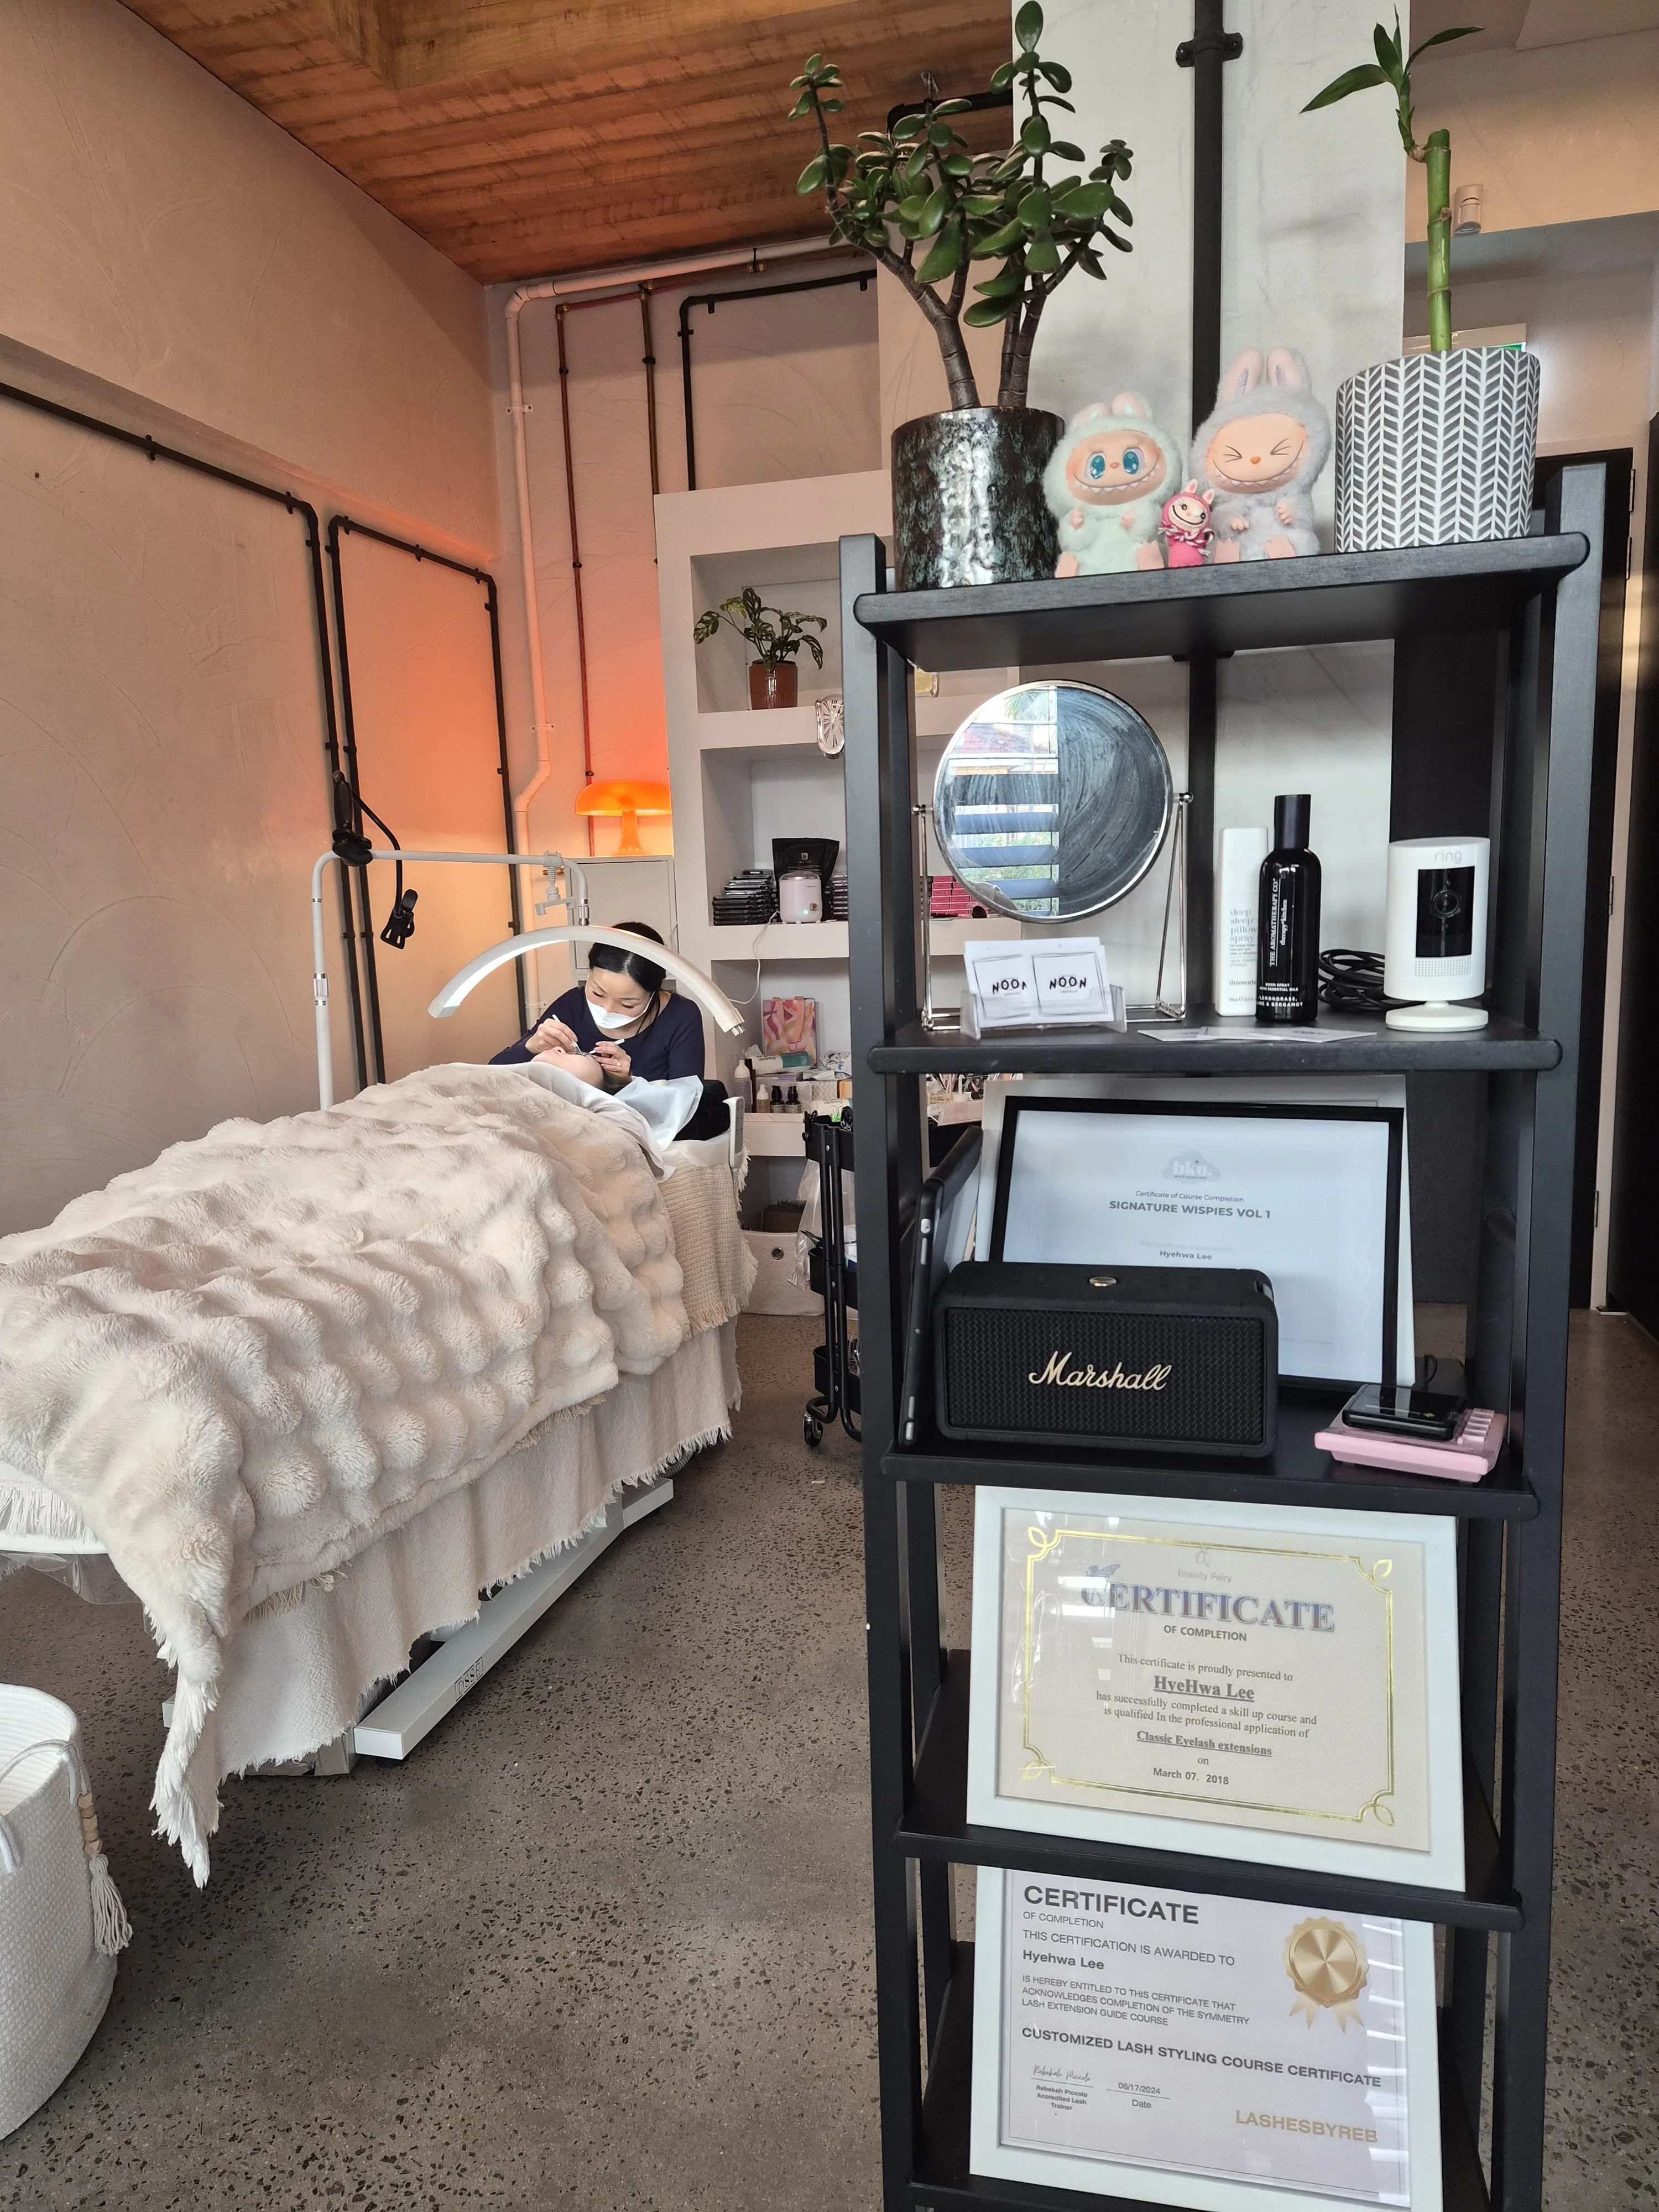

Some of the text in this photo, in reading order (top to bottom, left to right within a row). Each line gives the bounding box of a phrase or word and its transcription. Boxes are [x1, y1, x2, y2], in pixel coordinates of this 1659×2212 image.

[1435, 849, 1462, 864] ring
[1230, 909, 1251, 917] deep
[1230, 935, 1254, 943] spray
[1231, 926, 1256, 935] pillow
[1050, 977, 1087, 990] NOON
[1135, 1190, 1170, 1198] Certificate
[1109, 1201, 1178, 1213] SIGNATURE
[1181, 1204, 1233, 1217] WISPIES
[1237, 1208, 1262, 1218] VOL
[1160, 1250, 1194, 1259] Hyehwa
[1029, 1350, 1172, 1391] Marshall
[1081, 1582, 1335, 1632] CERTIFICATE
[1164, 1624, 1247, 1642] OF COMPLETION
[1118, 1653, 1293, 1681] This certificate is proudly presented to
[1154, 1675, 1255, 1700] HyeHwa Lee
[1096, 1691, 1112, 1701] has
[1114, 1694, 1167, 1710] successfully
[1171, 1701, 1218, 1715] completed
[1229, 1707, 1249, 1717] skill
[1252, 1710, 1263, 1720] up
[1266, 1712, 1297, 1723] course
[1300, 1715, 1317, 1725] and
[1114, 1708, 1154, 1721] qualified
[1157, 1712, 1166, 1721] In
[1168, 1714, 1183, 1724] the
[1185, 1716, 1241, 1730] professional
[1244, 1723, 1296, 1738] application
[1298, 1728, 1311, 1738] of
[1136, 1730, 1272, 1756] Classic Eyelash extensions
[1153, 1767, 1229, 1785] March 07. 2018
[1024, 1885, 1198, 1925] CERTIFICATE
[1023, 1911, 1104, 1928] OF COMPLETION
[1023, 1929, 1235, 1966] THIS CERTIFICATION IS AWARDED TO
[1022, 1950, 1104, 1970] Hyehwa Lee
[1032, 1976, 1068, 1987] HEREBY
[1070, 1981, 1112, 1993] ENTITLED
[1114, 1987, 1126, 1996] TO
[1129, 1989, 1149, 1999] THIS
[1151, 1992, 1209, 2007] CERTIFICATE
[1212, 2001, 1235, 2011] THAT
[1022, 1987, 1250, 2025] ACKNOWLEDGES COMPLETION OF THE SYMMETRY
[1022, 1999, 1169, 2026] LASH EXTENSION GUIDE COURSE
[1022, 2027, 1381, 2087] CUSTOMIZED LASH STYLING COURSE CERTIFICATE
[1036, 2085, 1088, 2098] Rebekah Piccolo
[1118, 2083, 1160, 2094] 06/17/2024
[1037, 2093, 1070, 2103] Accredited
[1051, 2103, 1072, 2111] Trainer
[1132, 2099, 1151, 2109] Date
[1236, 2110, 1378, 2143] LASHESBYREB
